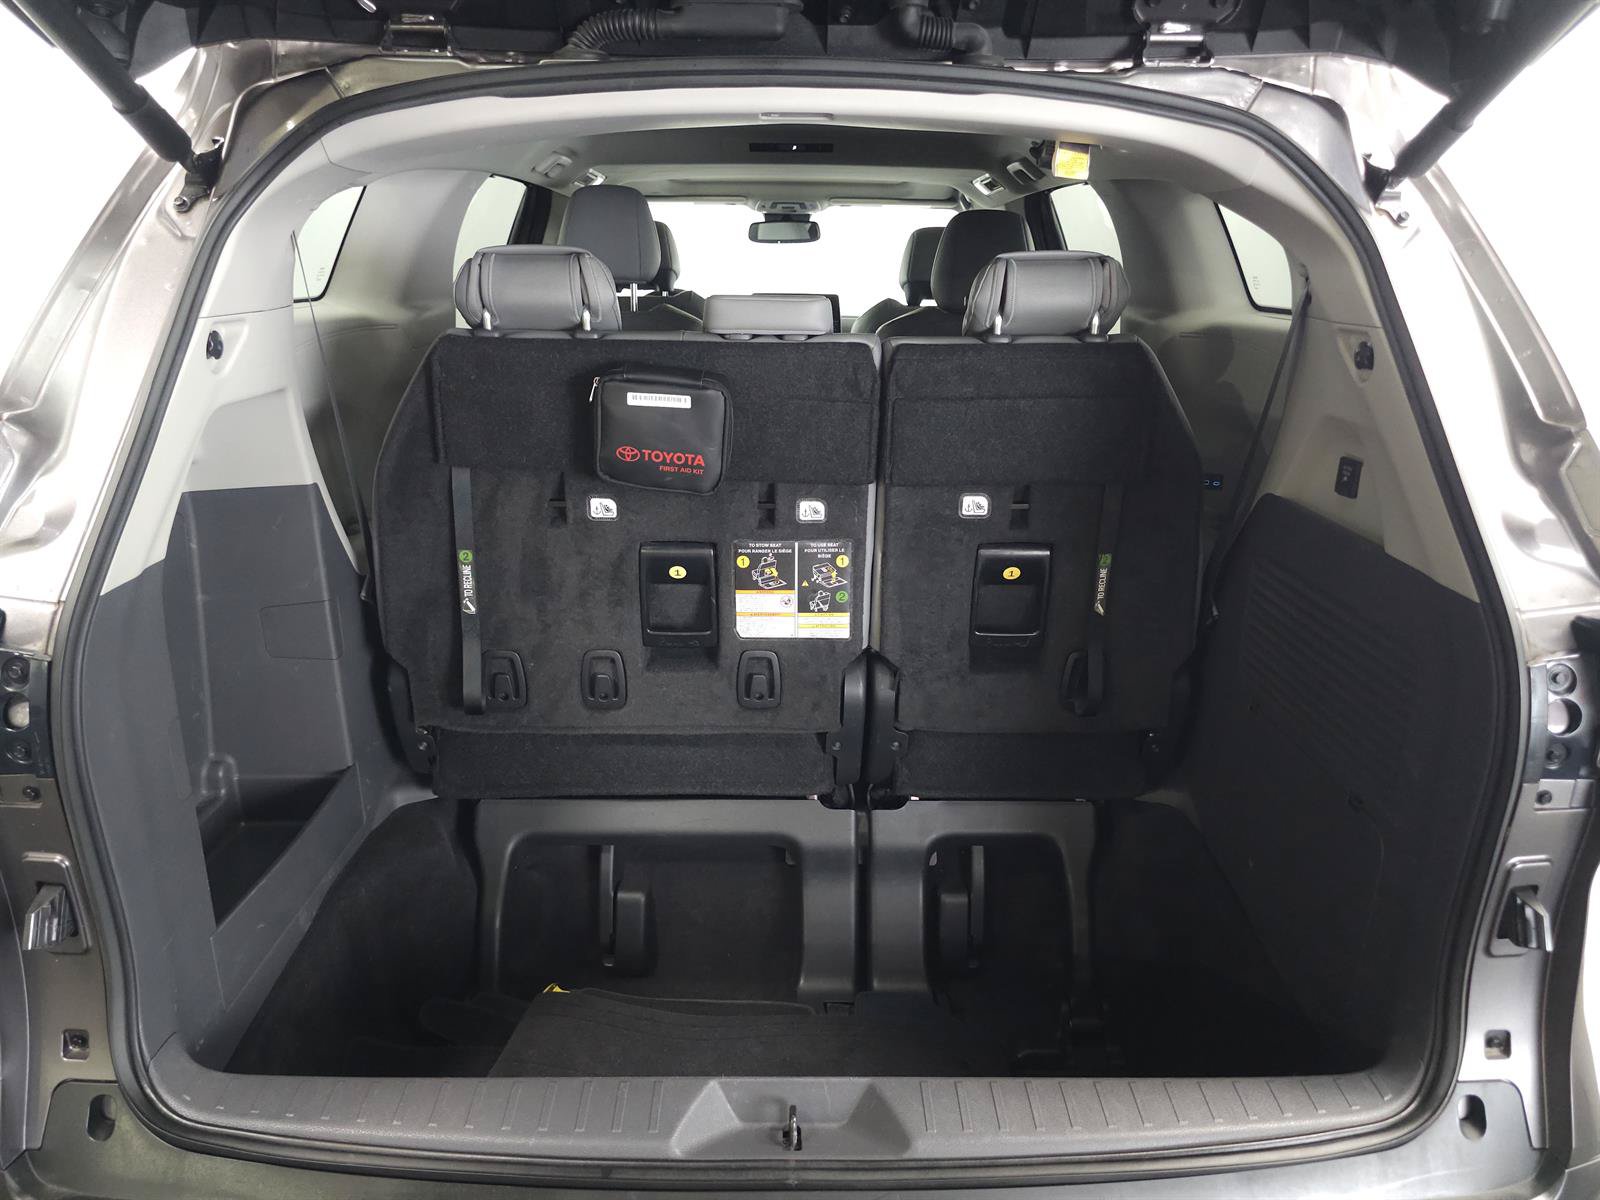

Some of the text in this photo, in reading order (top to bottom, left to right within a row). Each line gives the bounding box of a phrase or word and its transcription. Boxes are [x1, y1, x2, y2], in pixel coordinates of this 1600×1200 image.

[641, 449, 705, 467] TOYOTA
[680, 466, 692, 474] AID
[692, 467, 704, 475] KIT
[462, 564, 473, 598] TO RECLINE
[1097, 568, 1108, 600] TO RECLINE
